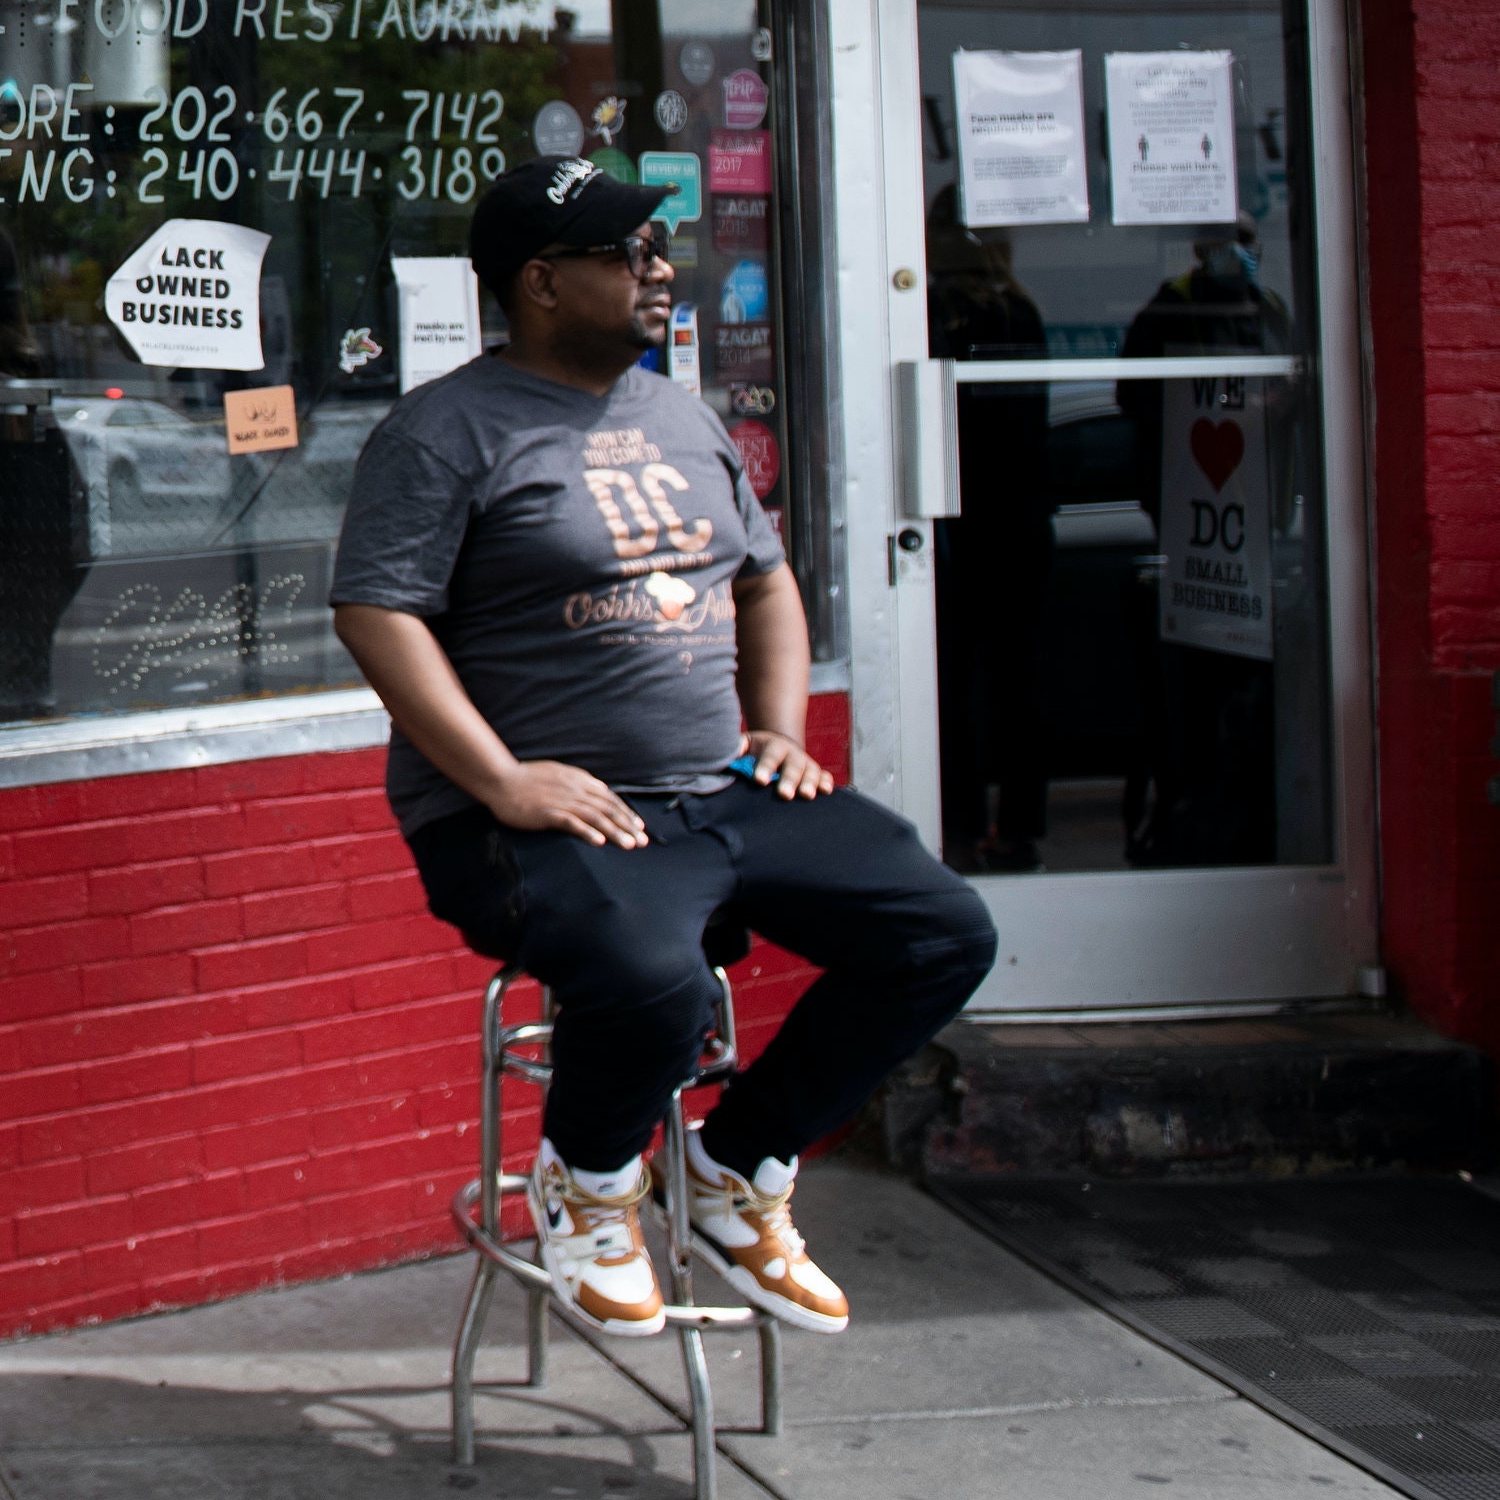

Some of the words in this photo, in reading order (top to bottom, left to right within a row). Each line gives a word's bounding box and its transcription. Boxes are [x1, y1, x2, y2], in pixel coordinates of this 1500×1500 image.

[715, 155, 743, 173] 2017
[161, 246, 225, 271] LACK
[136, 274, 231, 299] OWNED
[122, 301, 243, 330] BUSINESS
[715, 328, 771, 348] ZAGAT
[1193, 377, 1245, 412] WE
[582, 462, 714, 558] DC
[1190, 500, 1246, 554] DC
[1185, 556, 1248, 588] SMALL
[1171, 584, 1263, 621] BUSINESS
